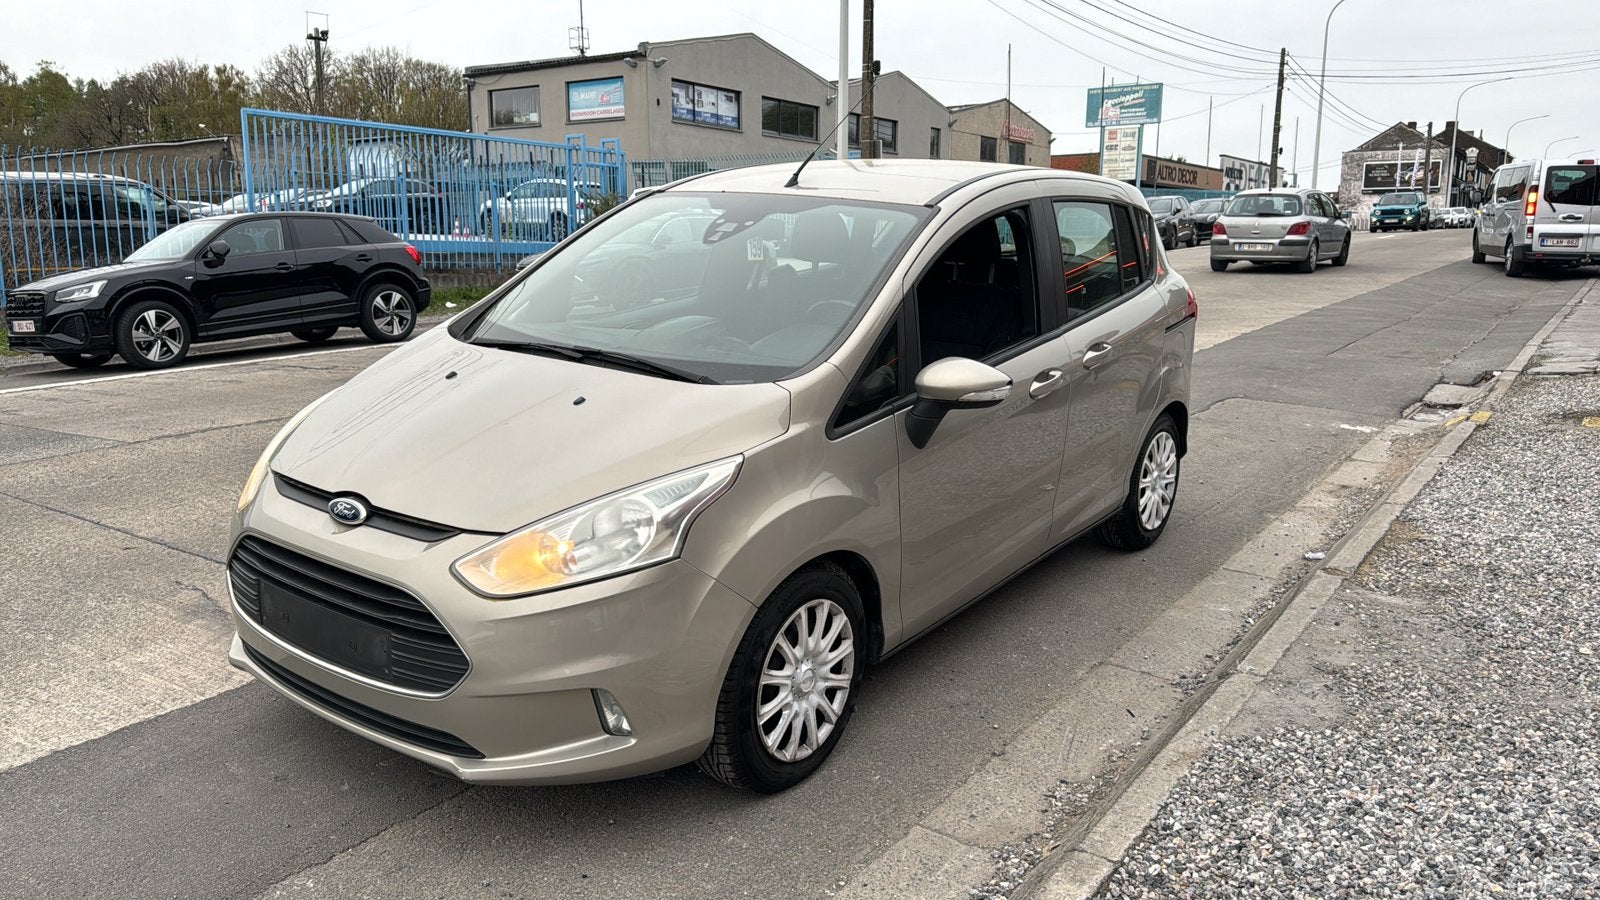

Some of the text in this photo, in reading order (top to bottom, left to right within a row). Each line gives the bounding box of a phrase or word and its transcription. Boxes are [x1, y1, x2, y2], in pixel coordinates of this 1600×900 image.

[571, 107, 624, 118] SHOWROOM CARRELAGES
[1158, 164, 1198, 185] ALTRO DECOR
[333, 502, 355, 519] Ford
